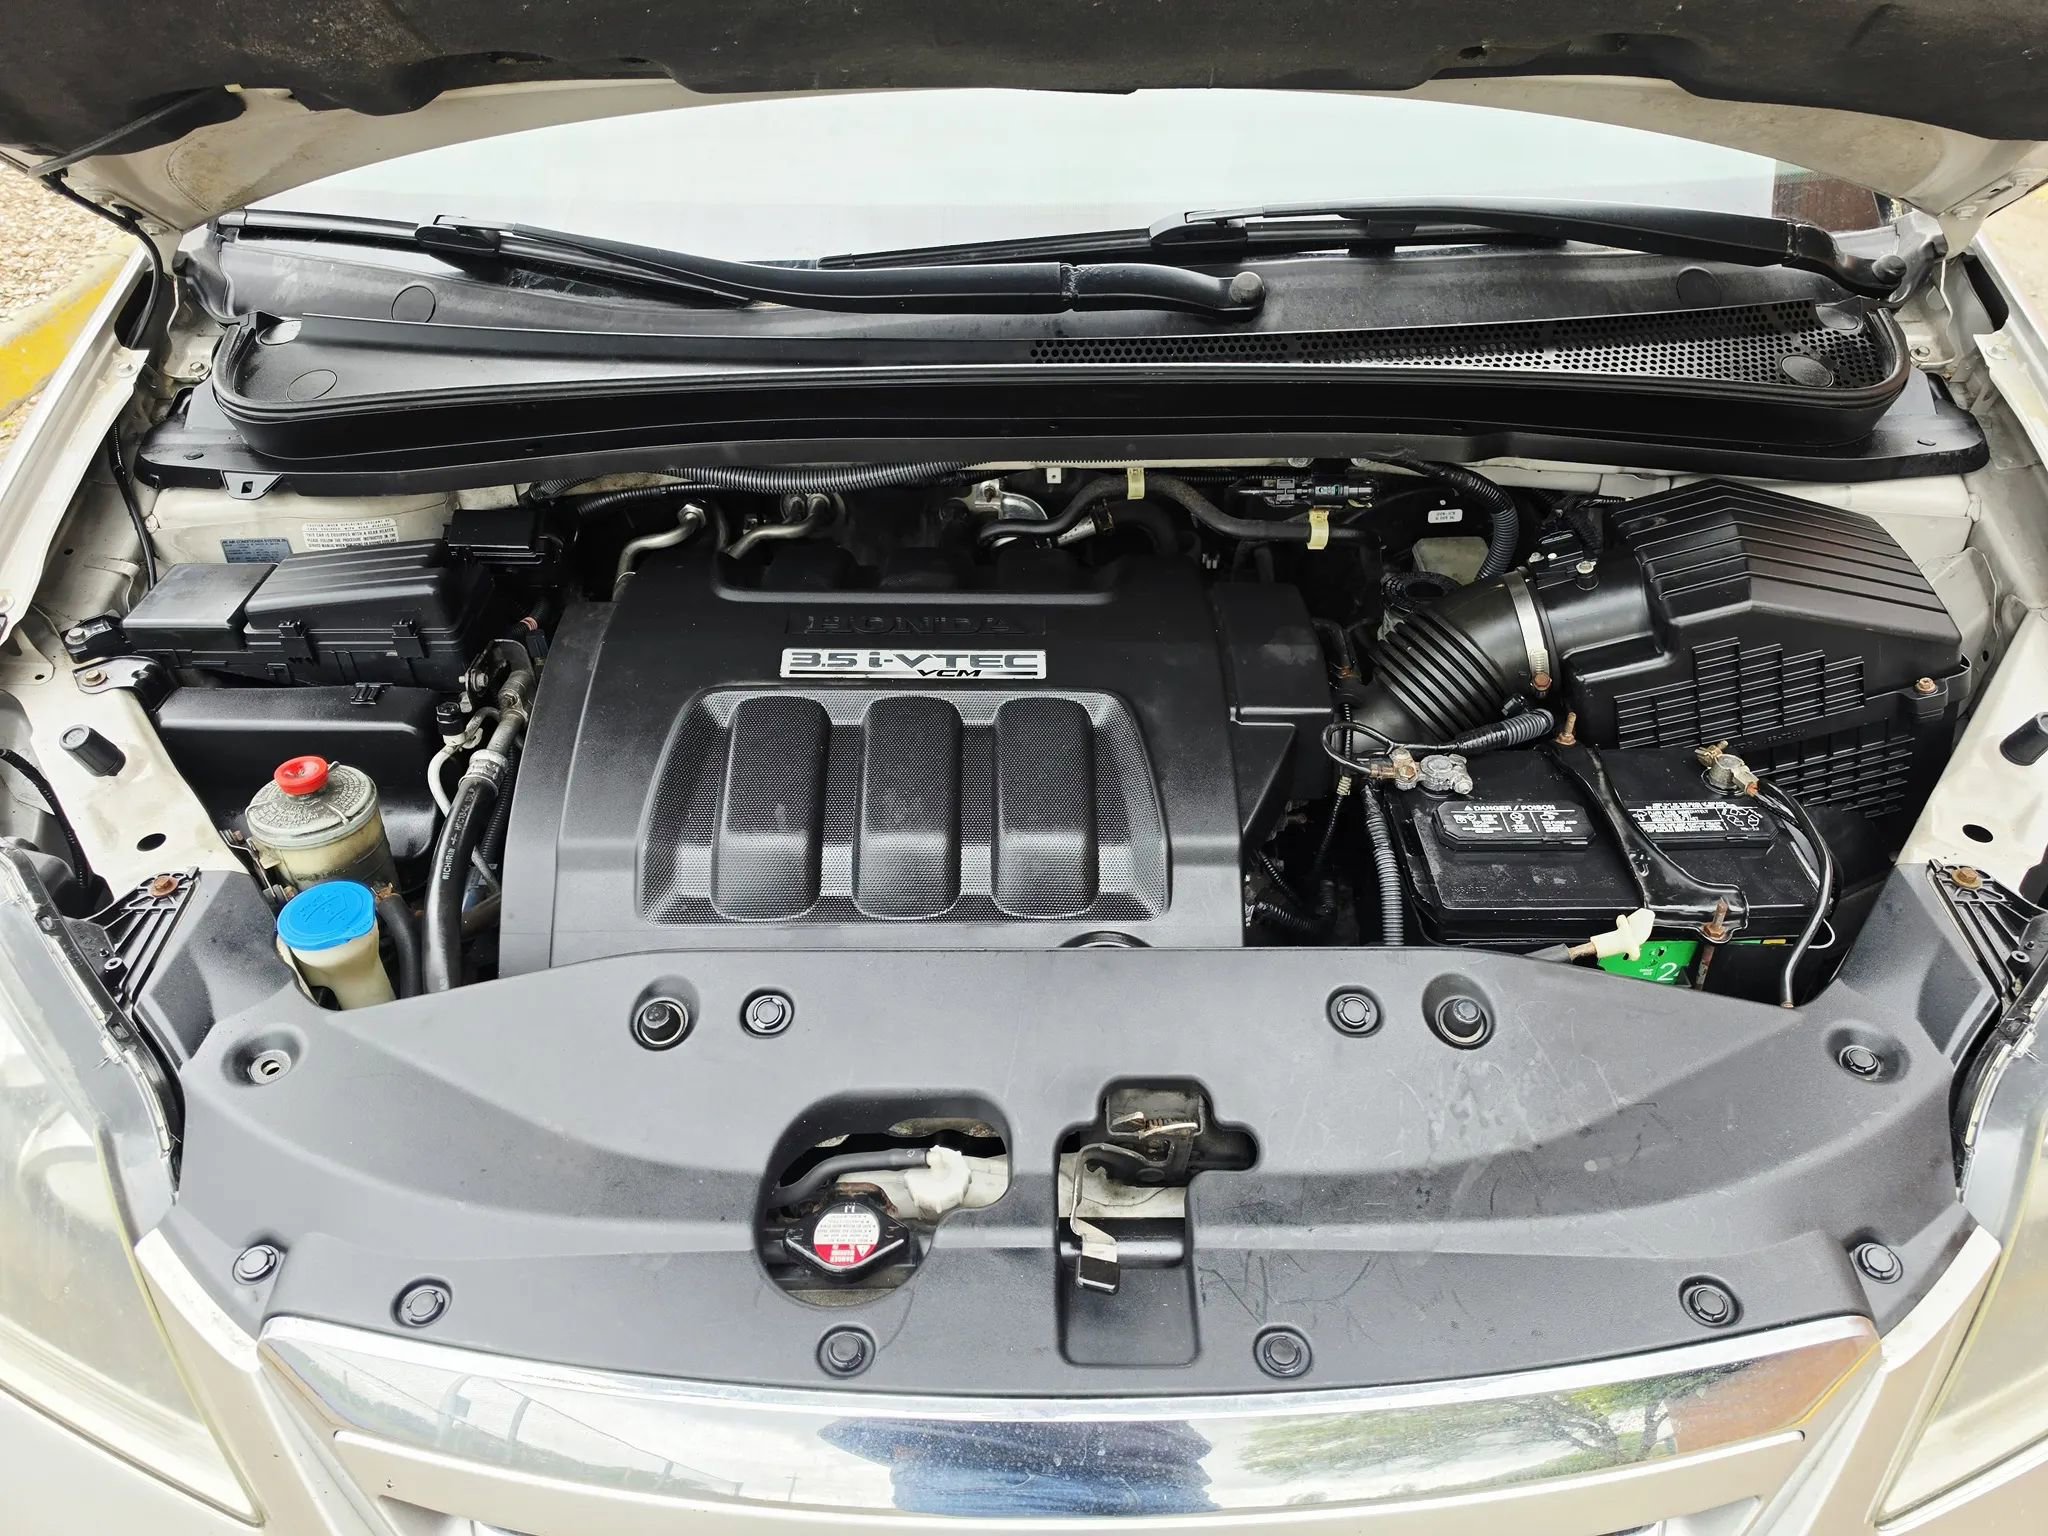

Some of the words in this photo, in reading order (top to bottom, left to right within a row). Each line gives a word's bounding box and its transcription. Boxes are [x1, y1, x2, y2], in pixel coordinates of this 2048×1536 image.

[805, 616, 1024, 634] HONDA
[790, 652, 858, 668] 3.5
[868, 652, 1038, 669] i-VTEC
[1657, 962, 1680, 980] 2
